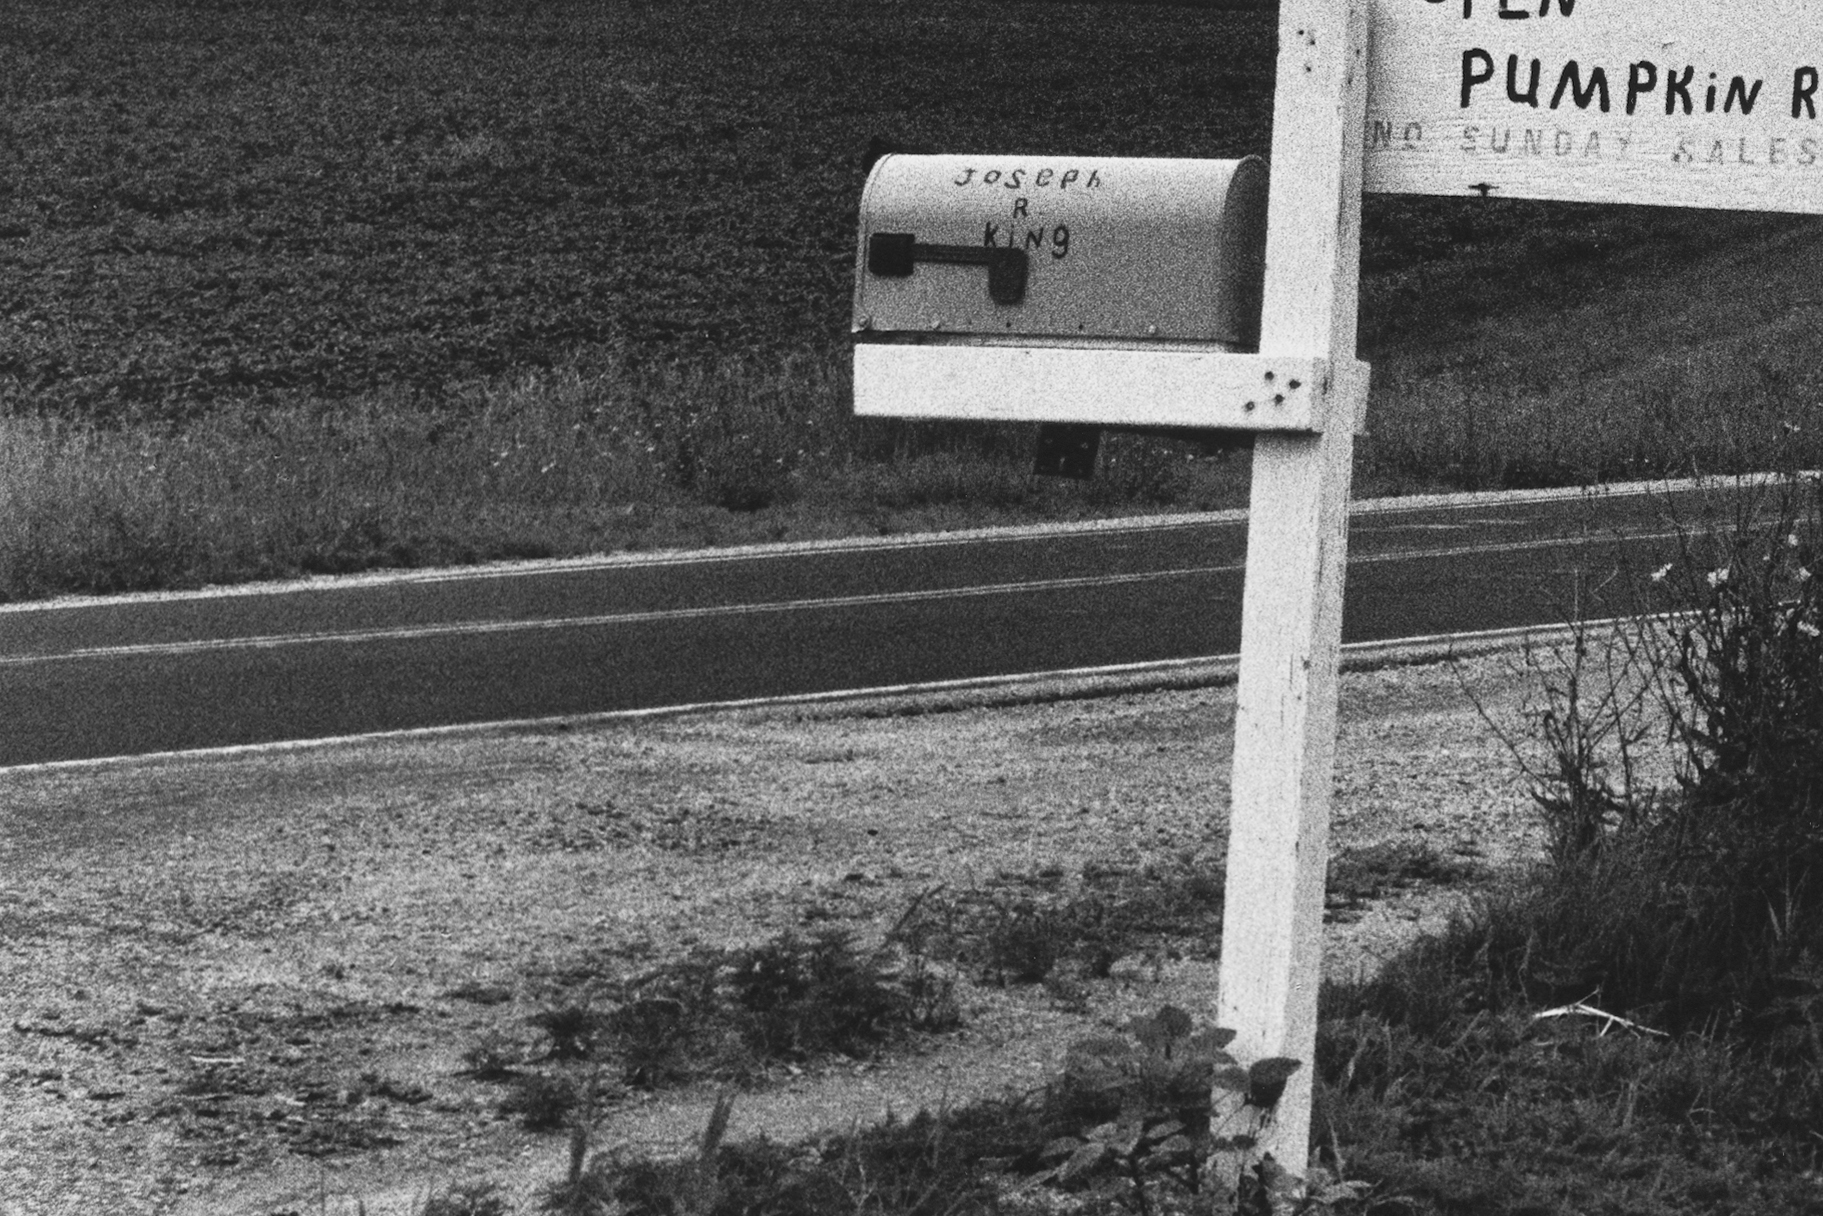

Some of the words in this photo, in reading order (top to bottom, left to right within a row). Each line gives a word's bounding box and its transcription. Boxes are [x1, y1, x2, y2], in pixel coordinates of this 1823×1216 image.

[1373, 120, 1424, 152] NO
[1459, 125, 1634, 162] SUNDAY
[1670, 135, 1818, 165] SALES
[1012, 196, 1029, 220] R
